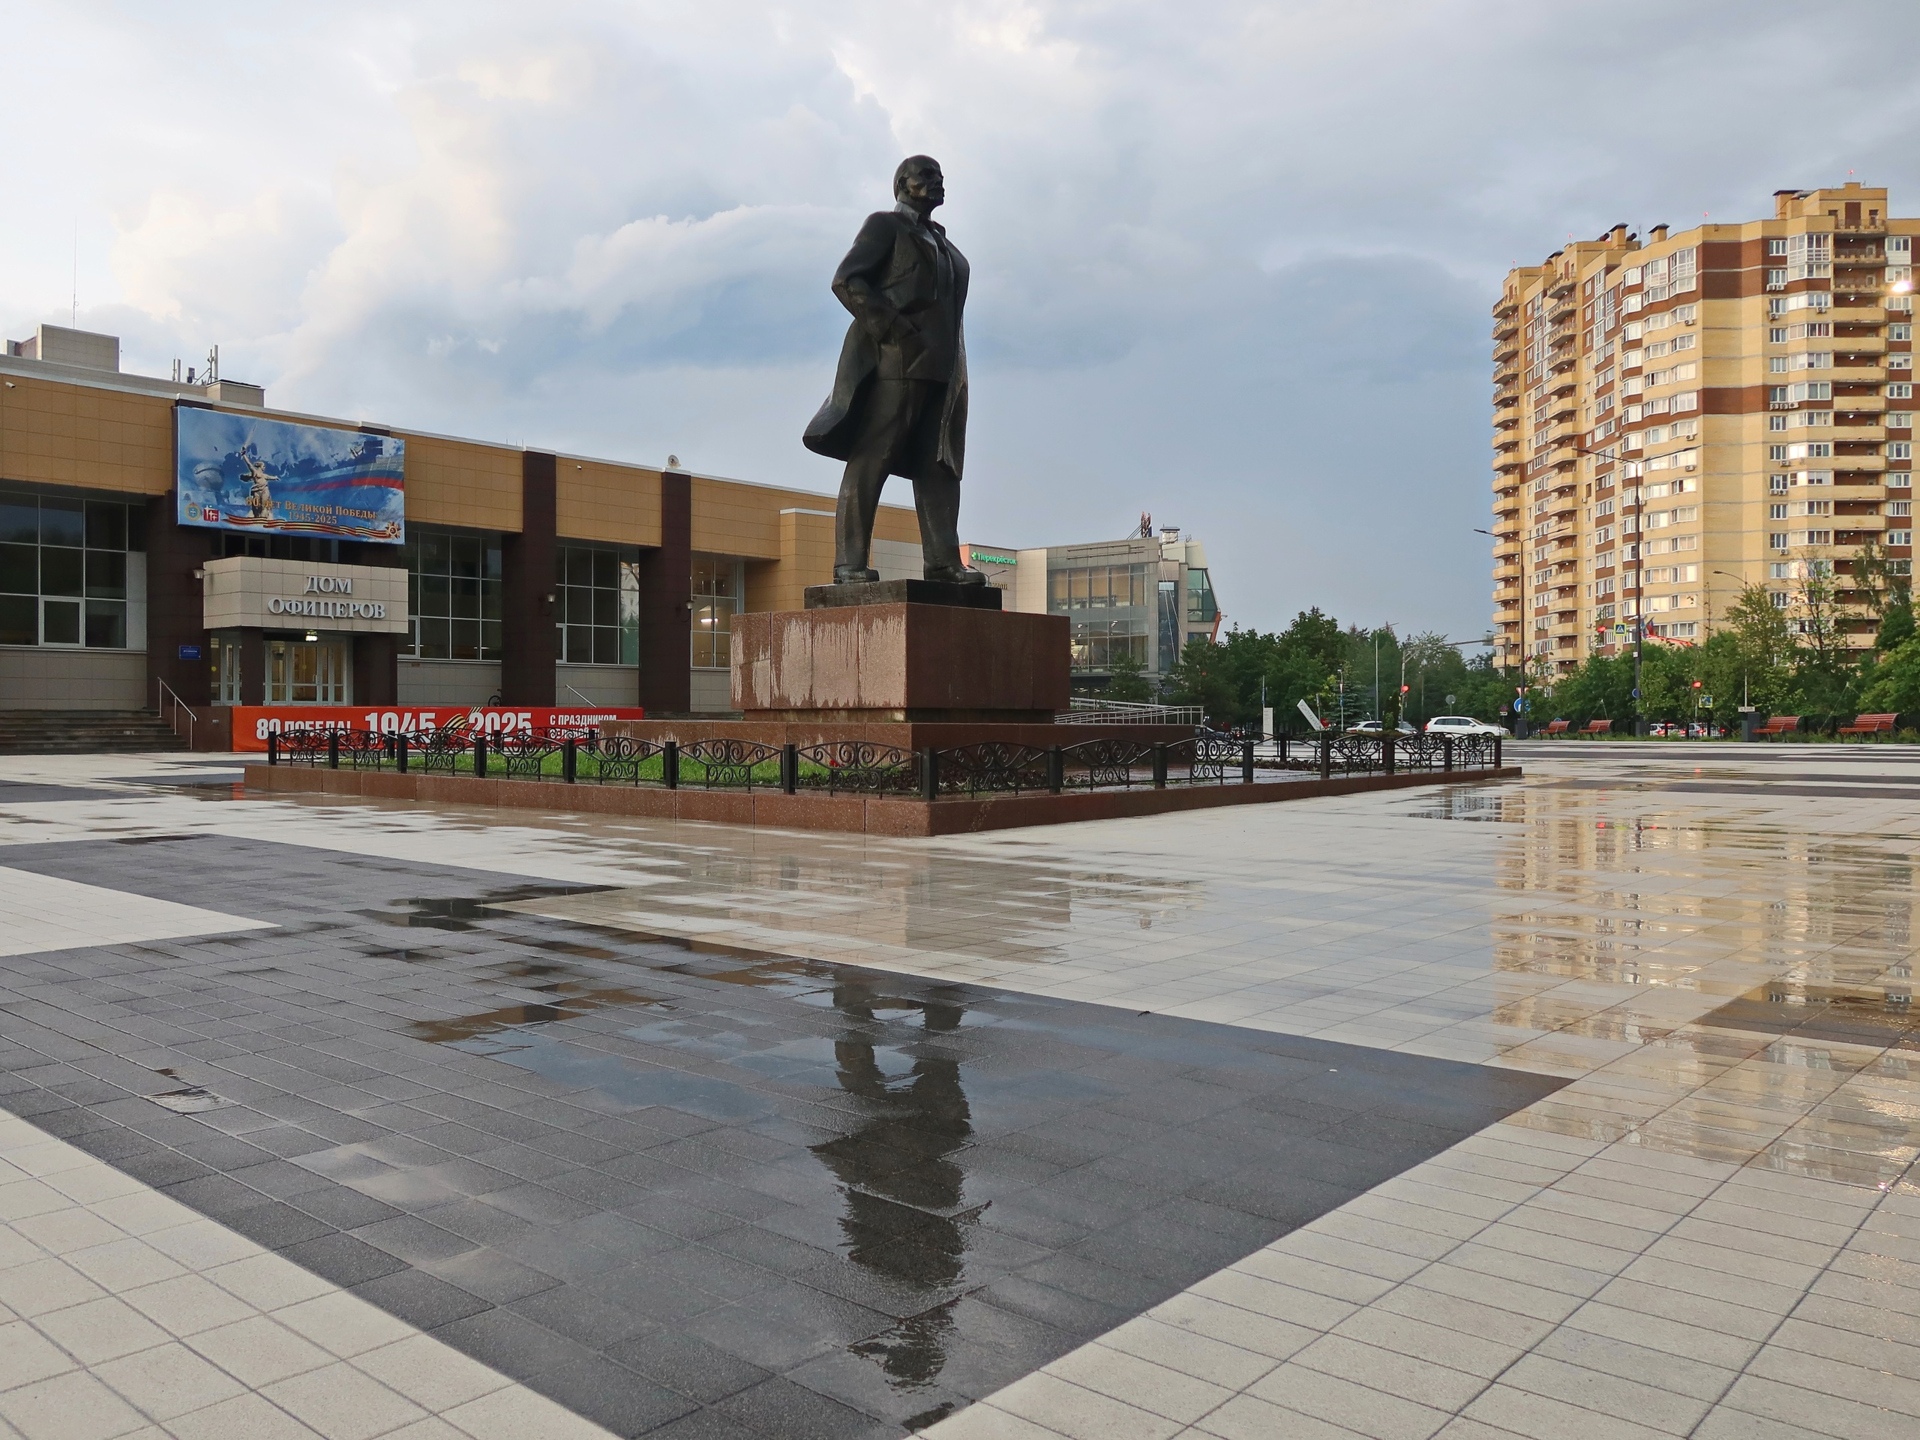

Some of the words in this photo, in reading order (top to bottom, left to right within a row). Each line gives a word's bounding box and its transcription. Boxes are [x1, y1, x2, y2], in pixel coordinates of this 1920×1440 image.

[289, 511, 338, 525] 1945-2025
[304, 575, 352, 595] ДОМ
[268, 597, 386, 620] ОФИЦЕРОВ
[256, 718, 281, 740] 80
[364, 711, 436, 743] 1945
[468, 711, 532, 742] 2025
[549, 714, 556, 725] С
